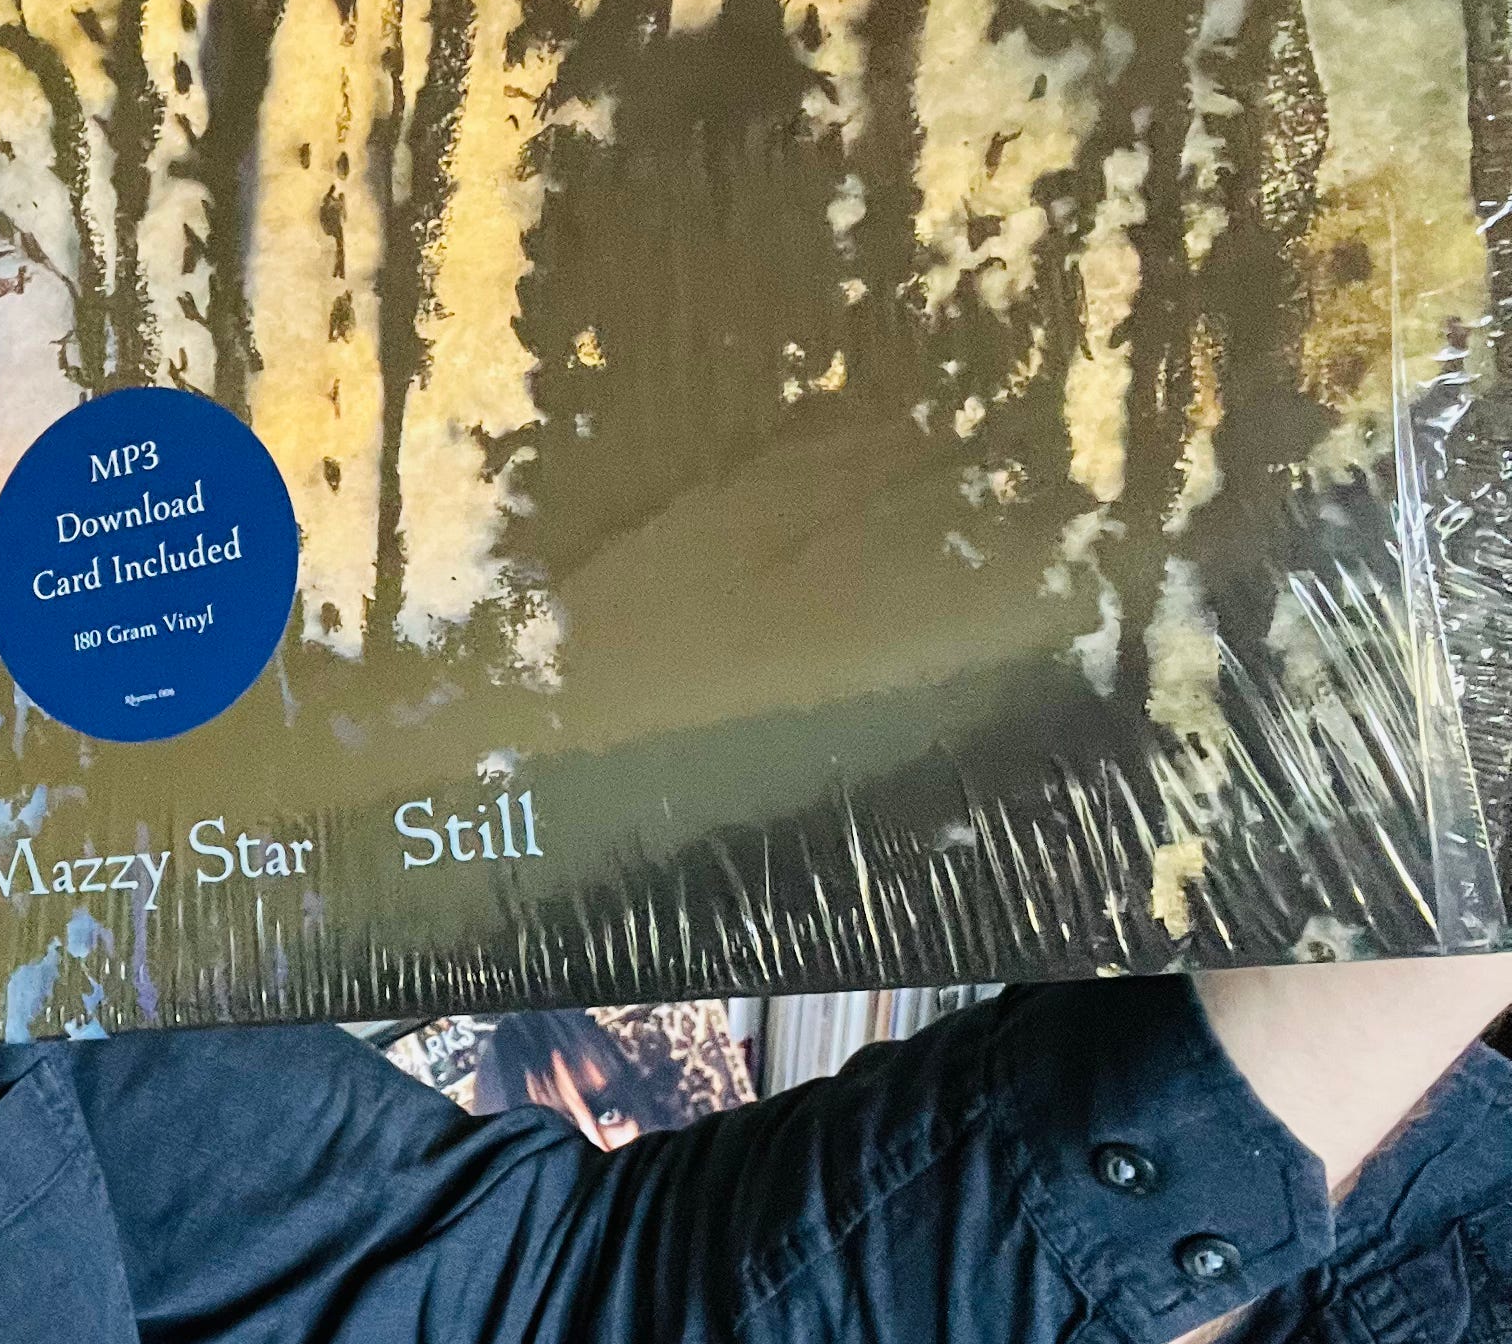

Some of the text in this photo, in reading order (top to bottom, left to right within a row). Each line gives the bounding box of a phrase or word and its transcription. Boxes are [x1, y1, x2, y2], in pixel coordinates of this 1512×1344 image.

[90, 440, 160, 483] MP3
[56, 479, 206, 543] Download
[32, 525, 243, 600] Card Included
[74, 603, 215, 651] 180 Gram Vinyl
[188, 815, 314, 887] Star
[394, 790, 544, 870] Still
